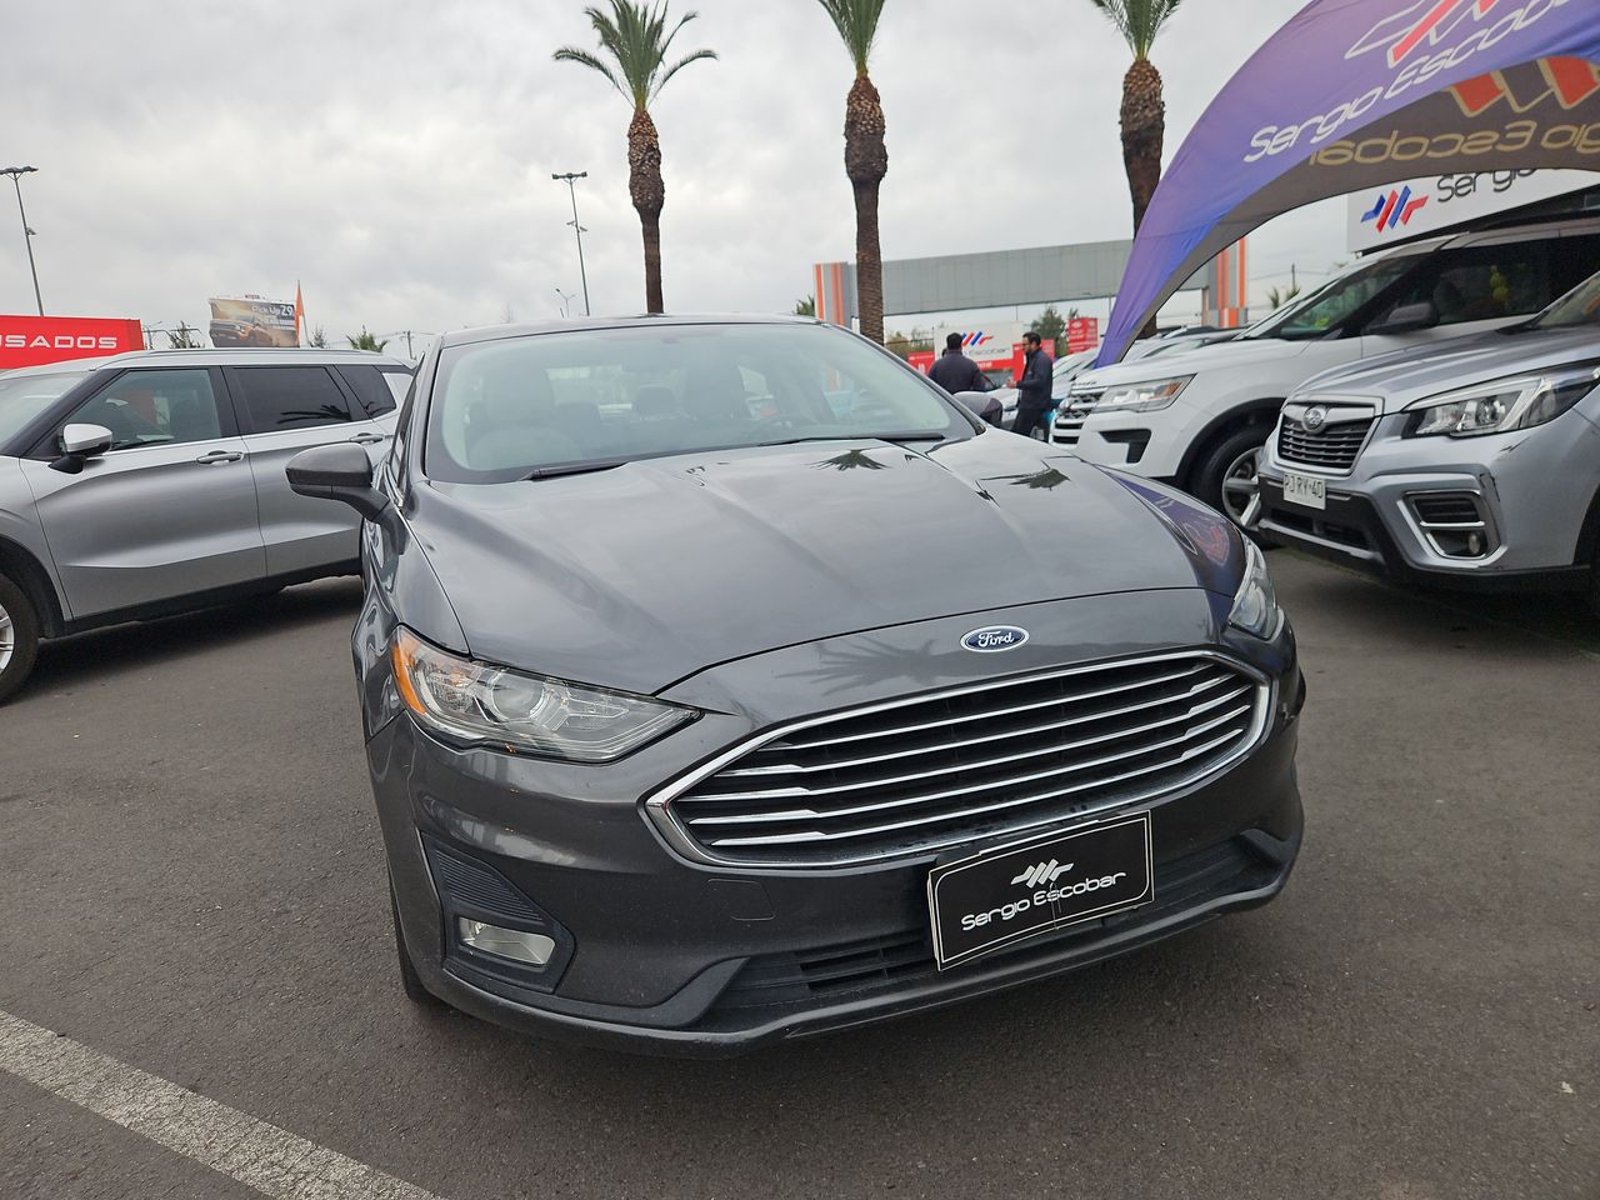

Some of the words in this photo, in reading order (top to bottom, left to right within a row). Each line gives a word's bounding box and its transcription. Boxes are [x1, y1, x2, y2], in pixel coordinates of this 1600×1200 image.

[1243, 86, 1383, 162] Sergio
[1384, 0, 1570, 99] Escob
[0, 334, 118, 349] SADOS
[978, 630, 1015, 648] Ford
[961, 899, 1031, 931] Sergio
[1033, 872, 1127, 906] Escobar
